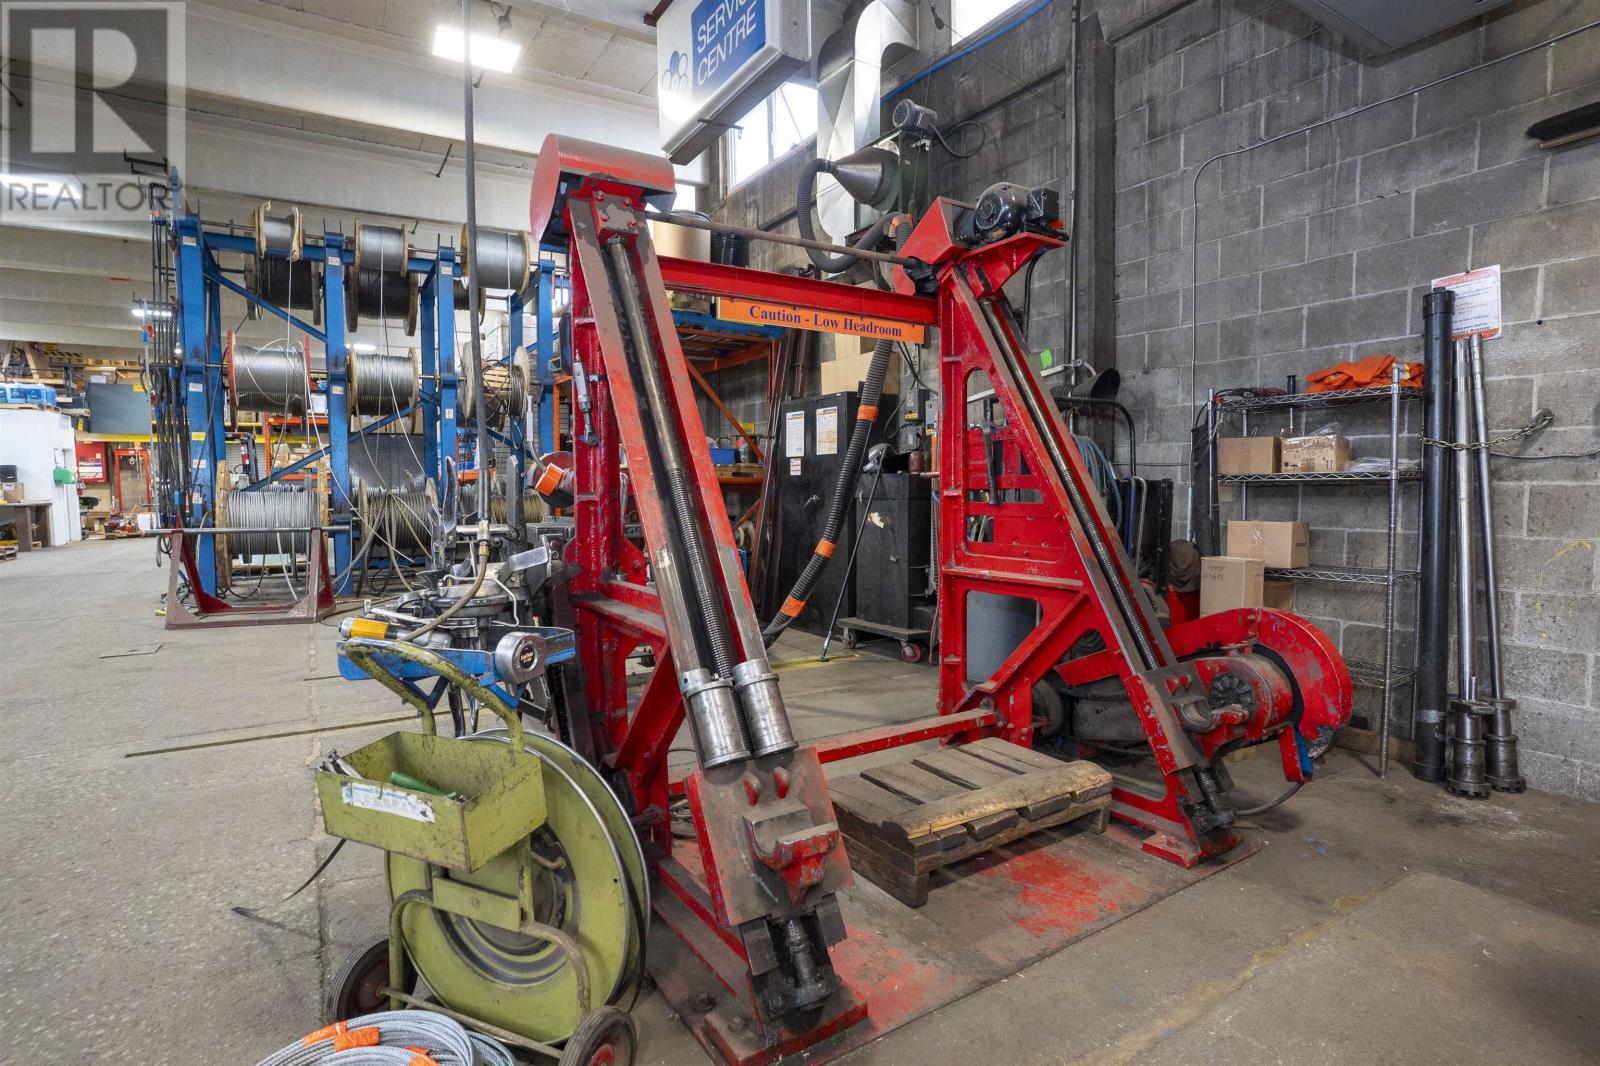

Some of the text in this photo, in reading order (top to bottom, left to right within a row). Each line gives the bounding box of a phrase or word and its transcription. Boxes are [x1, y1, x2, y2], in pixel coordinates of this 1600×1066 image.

[697, 0, 748, 54] SERV
[698, 0, 758, 86] CENTRE
[749, 306, 801, 323] Caution
[814, 313, 840, 329] Low
[843, 318, 902, 336] Headroom
